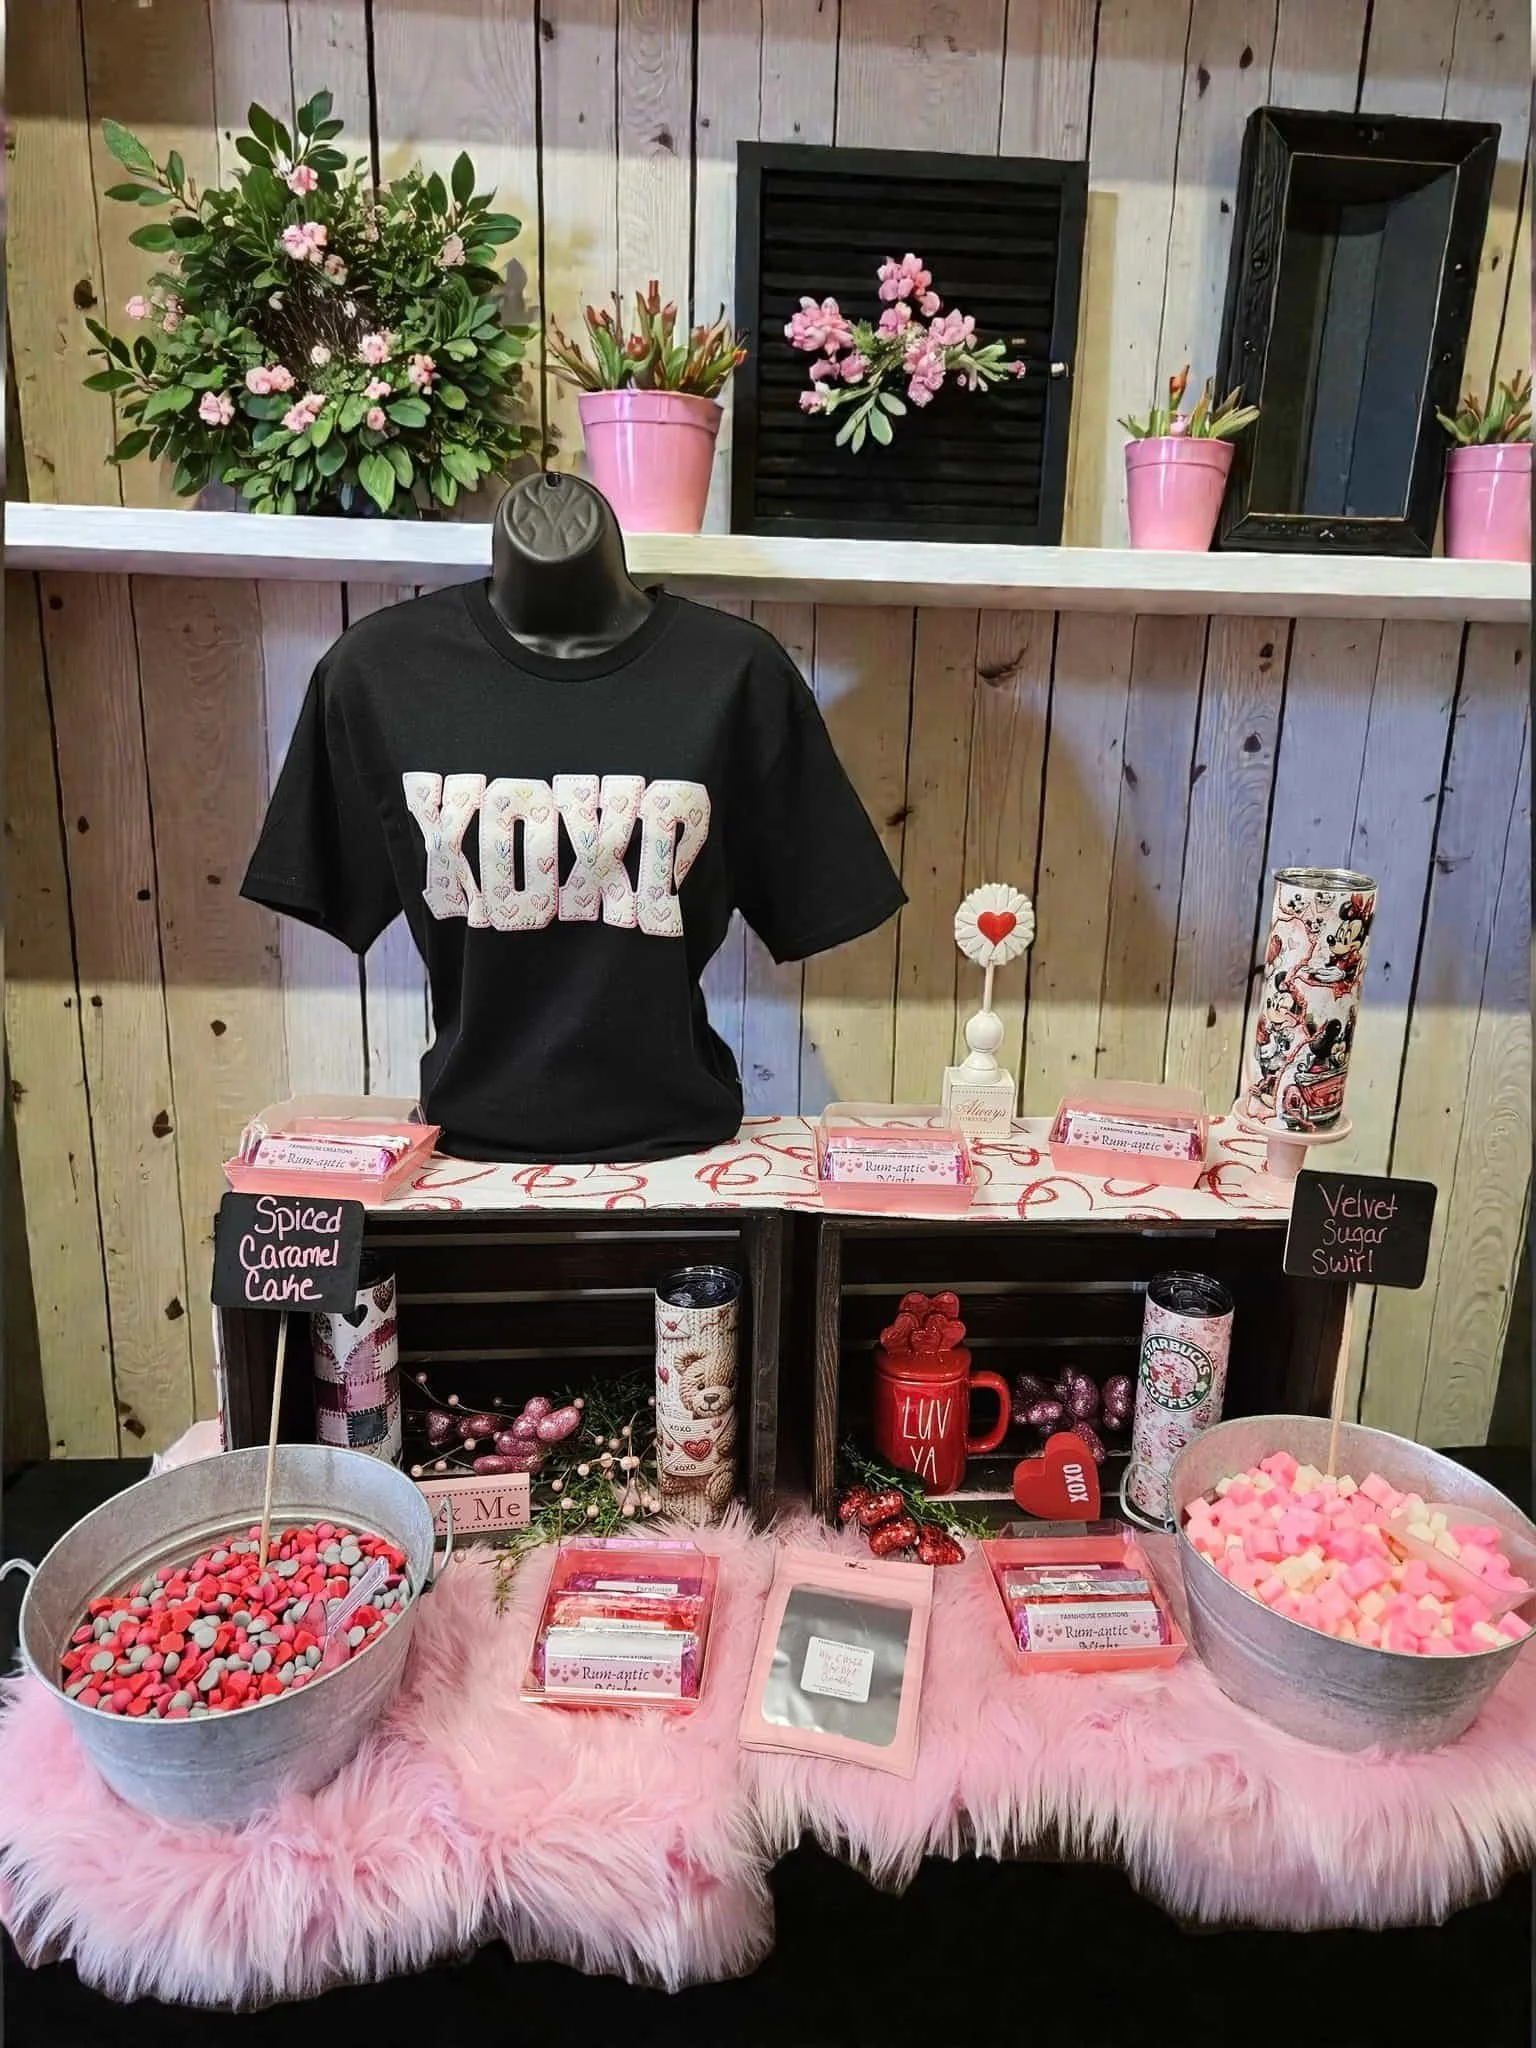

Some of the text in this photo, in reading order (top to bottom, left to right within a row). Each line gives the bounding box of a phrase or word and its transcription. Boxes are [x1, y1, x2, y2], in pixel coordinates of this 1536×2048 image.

[956, 1099, 1007, 1120] Always
[1101, 1135, 1161, 1152] Rum-antic
[287, 1152, 345, 1169] Rum-antic
[865, 1160, 926, 1173] Rum-antic
[1318, 1184, 1398, 1220] Velvet
[254, 1196, 342, 1240] Spiced
[1322, 1219, 1388, 1254] Sugar
[239, 1234, 339, 1271] Caramel
[1312, 1249, 1372, 1275] Swirl
[244, 1269, 322, 1302] Cake
[1144, 1338, 1210, 1376] STARBUCKS
[1145, 1378, 1199, 1408] COFFEE
[669, 1423, 692, 1433] XOXO
[903, 1396, 952, 1440] LUV
[674, 1463, 697, 1472] XOXO
[910, 1446, 938, 1485] YA
[473, 1496, 521, 1521] Me
[1065, 1625, 1129, 1639] Rum-antic
[582, 1666, 650, 1680] Rum-antic
